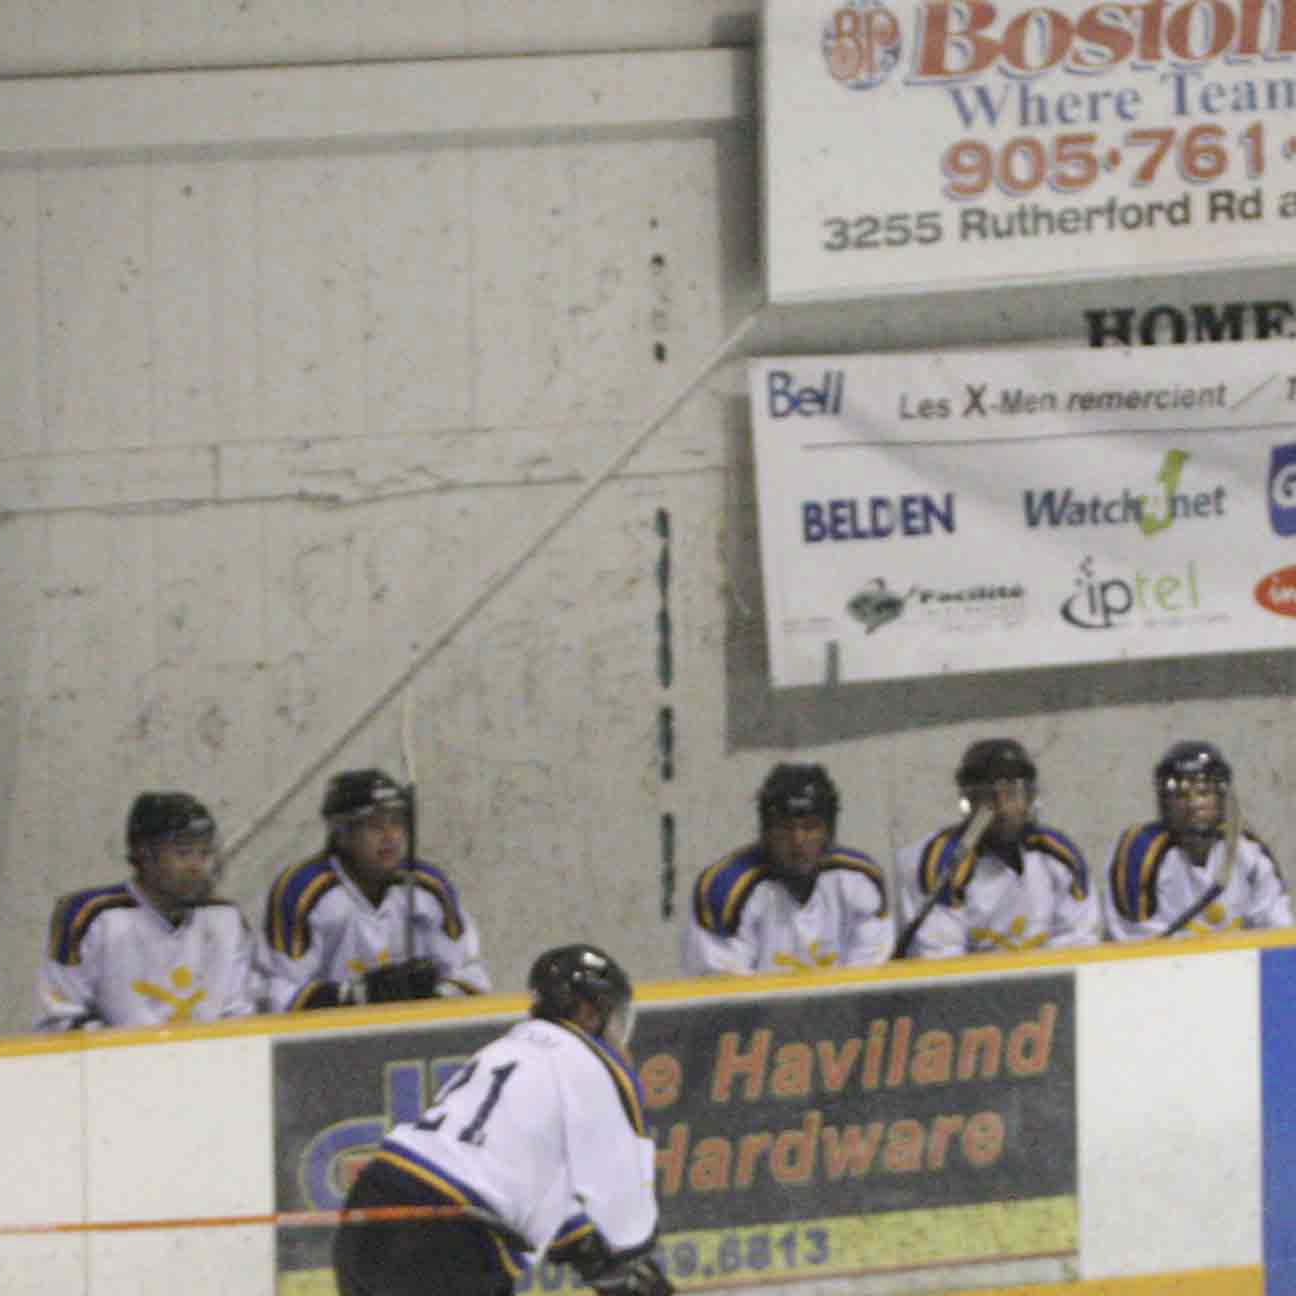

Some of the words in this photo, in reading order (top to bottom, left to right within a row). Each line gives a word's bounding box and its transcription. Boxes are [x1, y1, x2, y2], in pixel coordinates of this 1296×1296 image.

[949, 77, 1142, 129] Where
[822, 211, 943, 252] 3255
[959, 192, 1191, 241] Rutherford
[1208, 187, 1263, 224] Rd
[766, 370, 844, 420] Bell
[898, 391, 951, 421] Les
[961, 383, 1057, 420] X-Men
[1065, 382, 1228, 414] remercient
[803, 493, 957, 544] BELDEN
[711, 1002, 1058, 1104] Haviland
